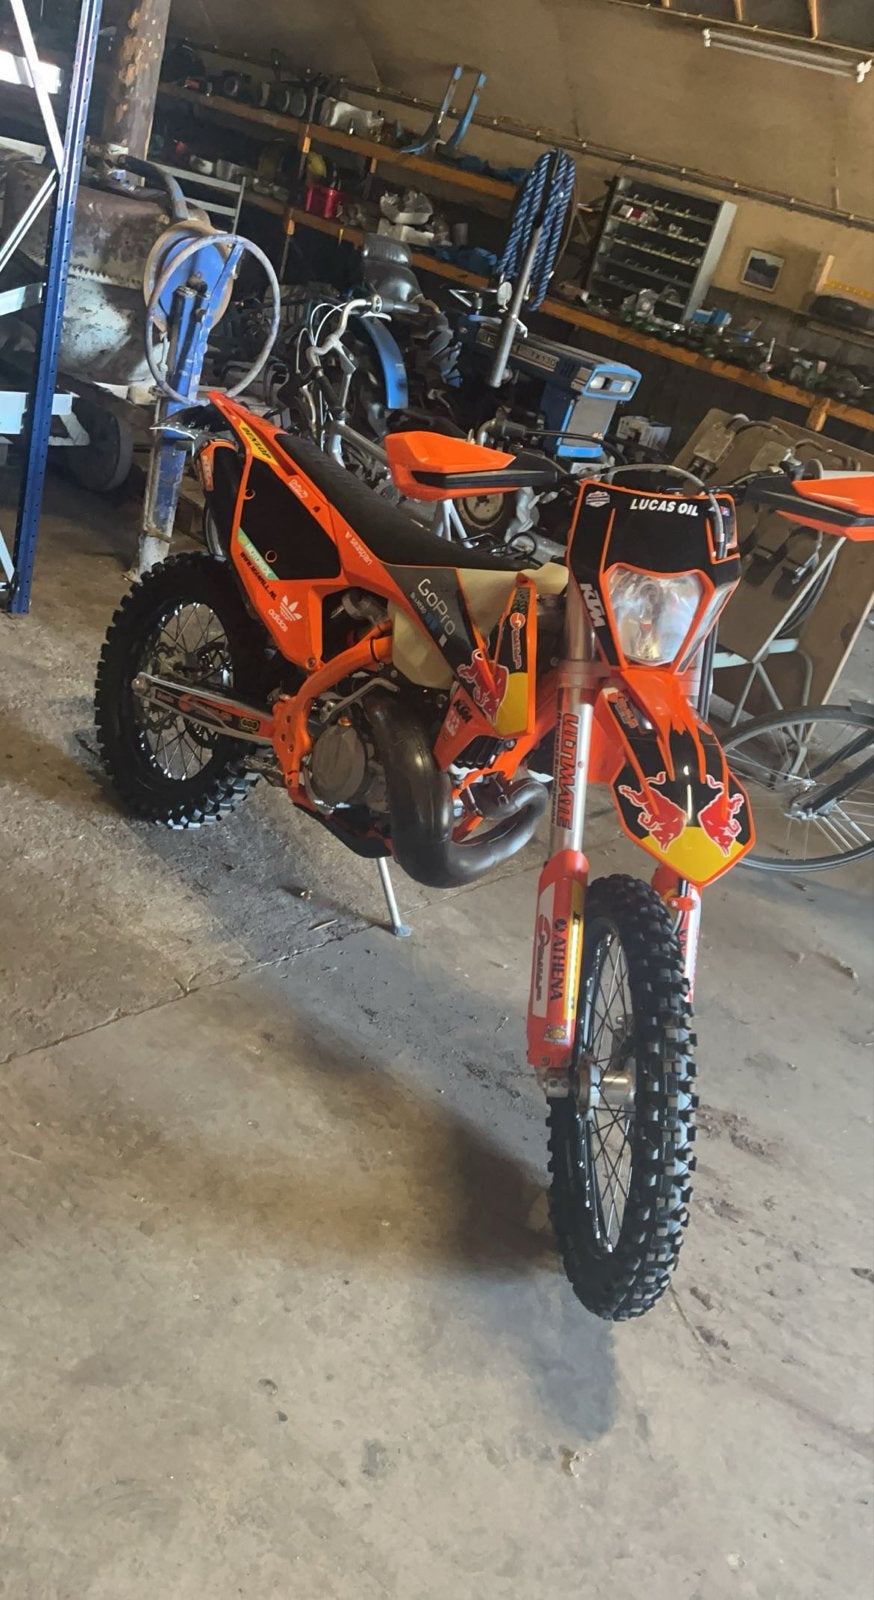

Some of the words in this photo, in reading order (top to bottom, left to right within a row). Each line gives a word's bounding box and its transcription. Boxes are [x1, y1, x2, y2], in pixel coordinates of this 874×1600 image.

[241, 427, 271, 459] DUNLOP
[630, 498, 676, 513] LUCAS
[677, 502, 699, 517] OIL
[268, 608, 288, 632] adidas
[418, 578, 455, 635] GoPro
[580, 583, 606, 627] KTM
[556, 713, 579, 830] ULTIMATE
[550, 936, 566, 1001] ATHENA
